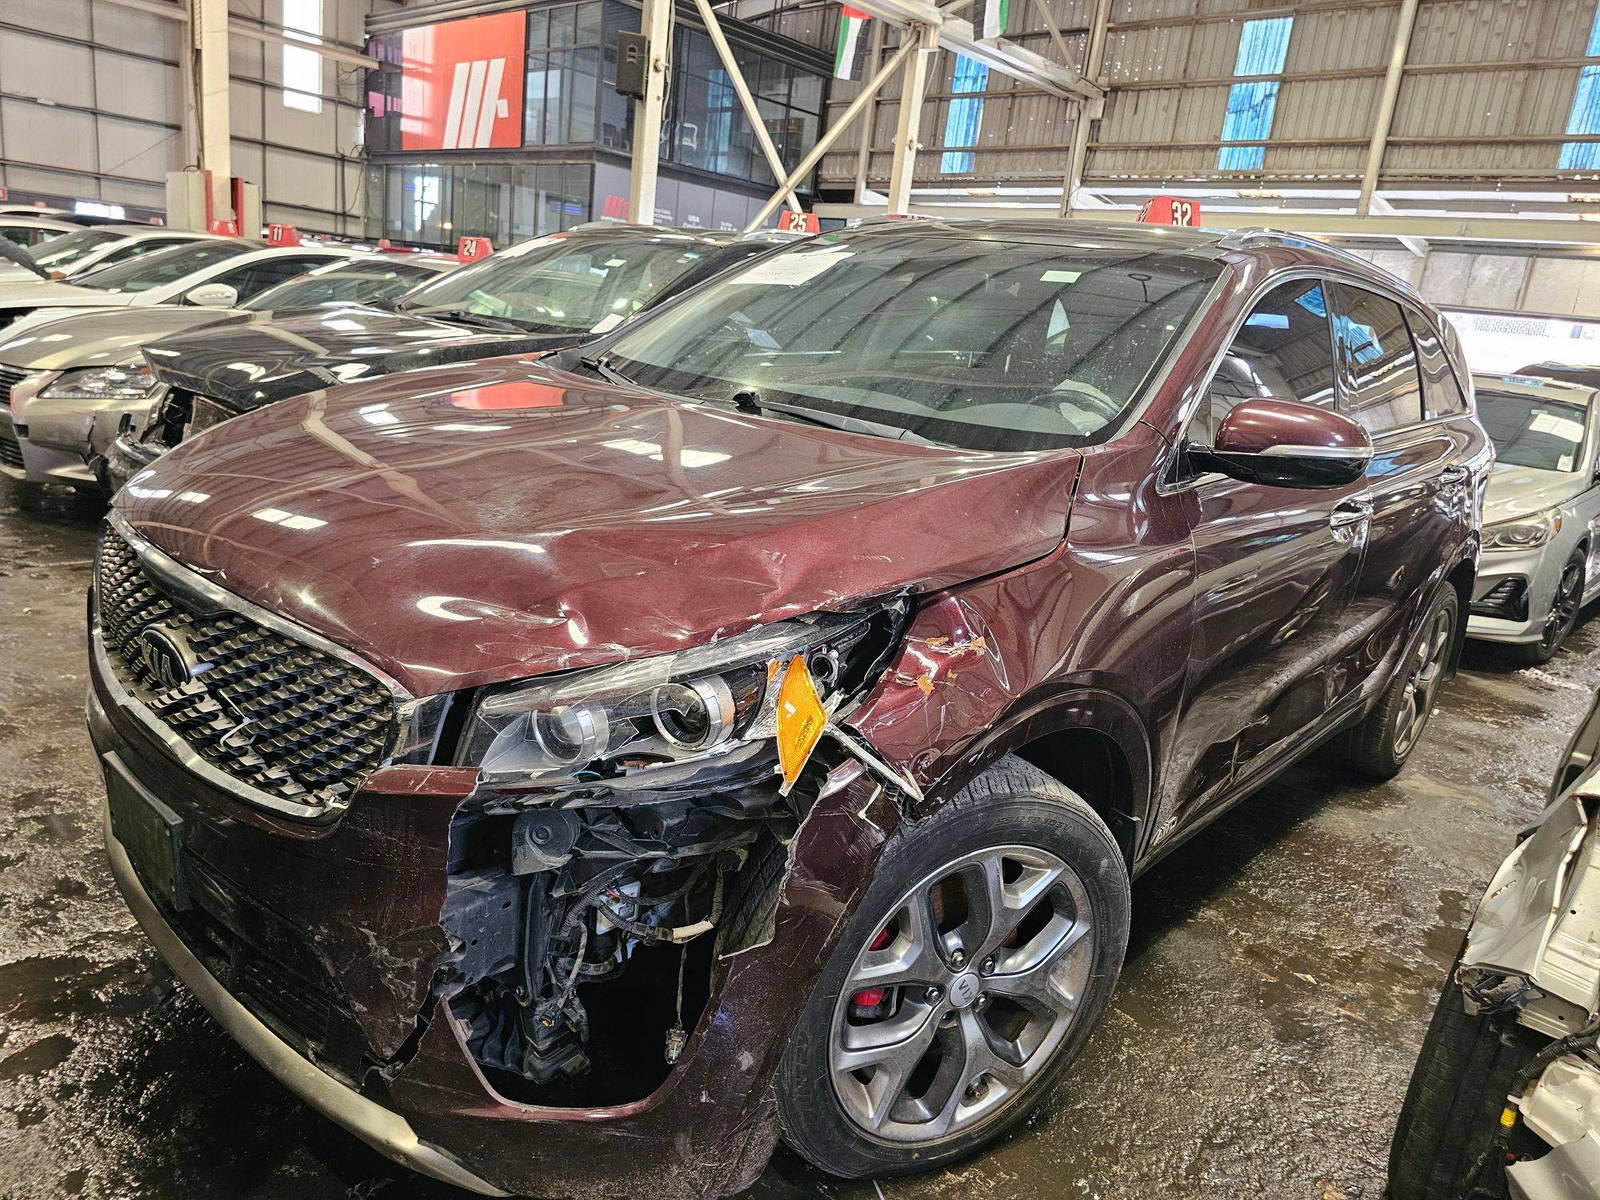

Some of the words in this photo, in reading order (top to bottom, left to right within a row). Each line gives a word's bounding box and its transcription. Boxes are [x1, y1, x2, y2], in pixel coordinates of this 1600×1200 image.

[789, 213, 807, 232] 25
[1171, 200, 1192, 227] 32
[273, 226, 283, 241] 11
[463, 239, 477, 257] 24
[141, 637, 178, 689] KIA
[958, 978, 974, 1005] KIA
